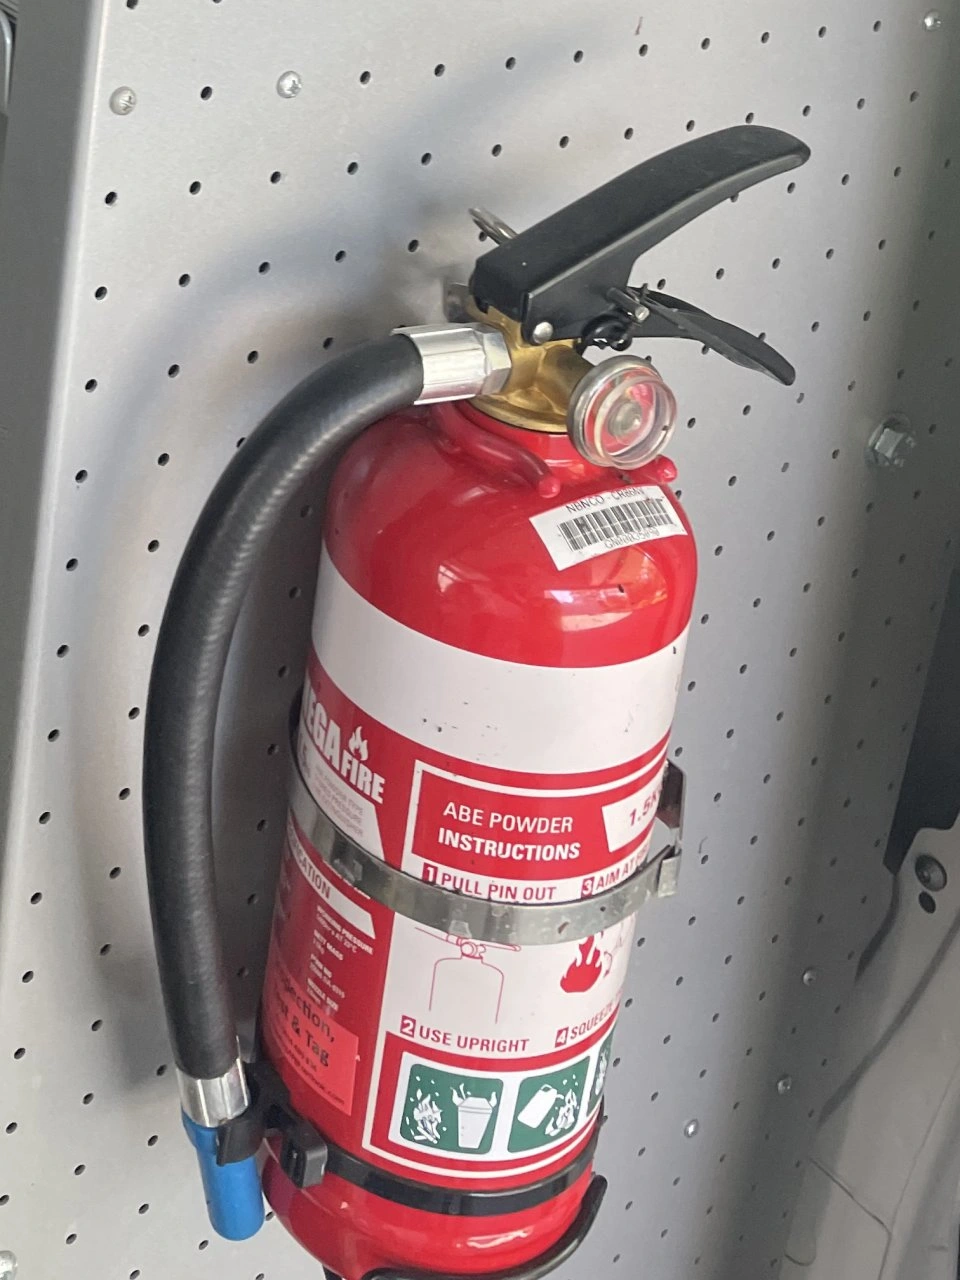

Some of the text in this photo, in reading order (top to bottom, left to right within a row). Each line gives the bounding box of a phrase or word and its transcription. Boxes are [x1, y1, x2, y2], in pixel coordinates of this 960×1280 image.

[341, 750, 385, 805] FIRE
[443, 801, 573, 834] ABE POWDER
[438, 827, 581, 861] INSTRUCTIONS
[441, 872, 483, 895] PULL
[488, 884, 518, 900] PIN
[523, 886, 557, 901] OUT
[596, 868, 620, 890] AIM
[305, 1029, 330, 1067] Tag
[419, 1025, 452, 1046] USE
[457, 1035, 530, 1053] UPRIGHT
